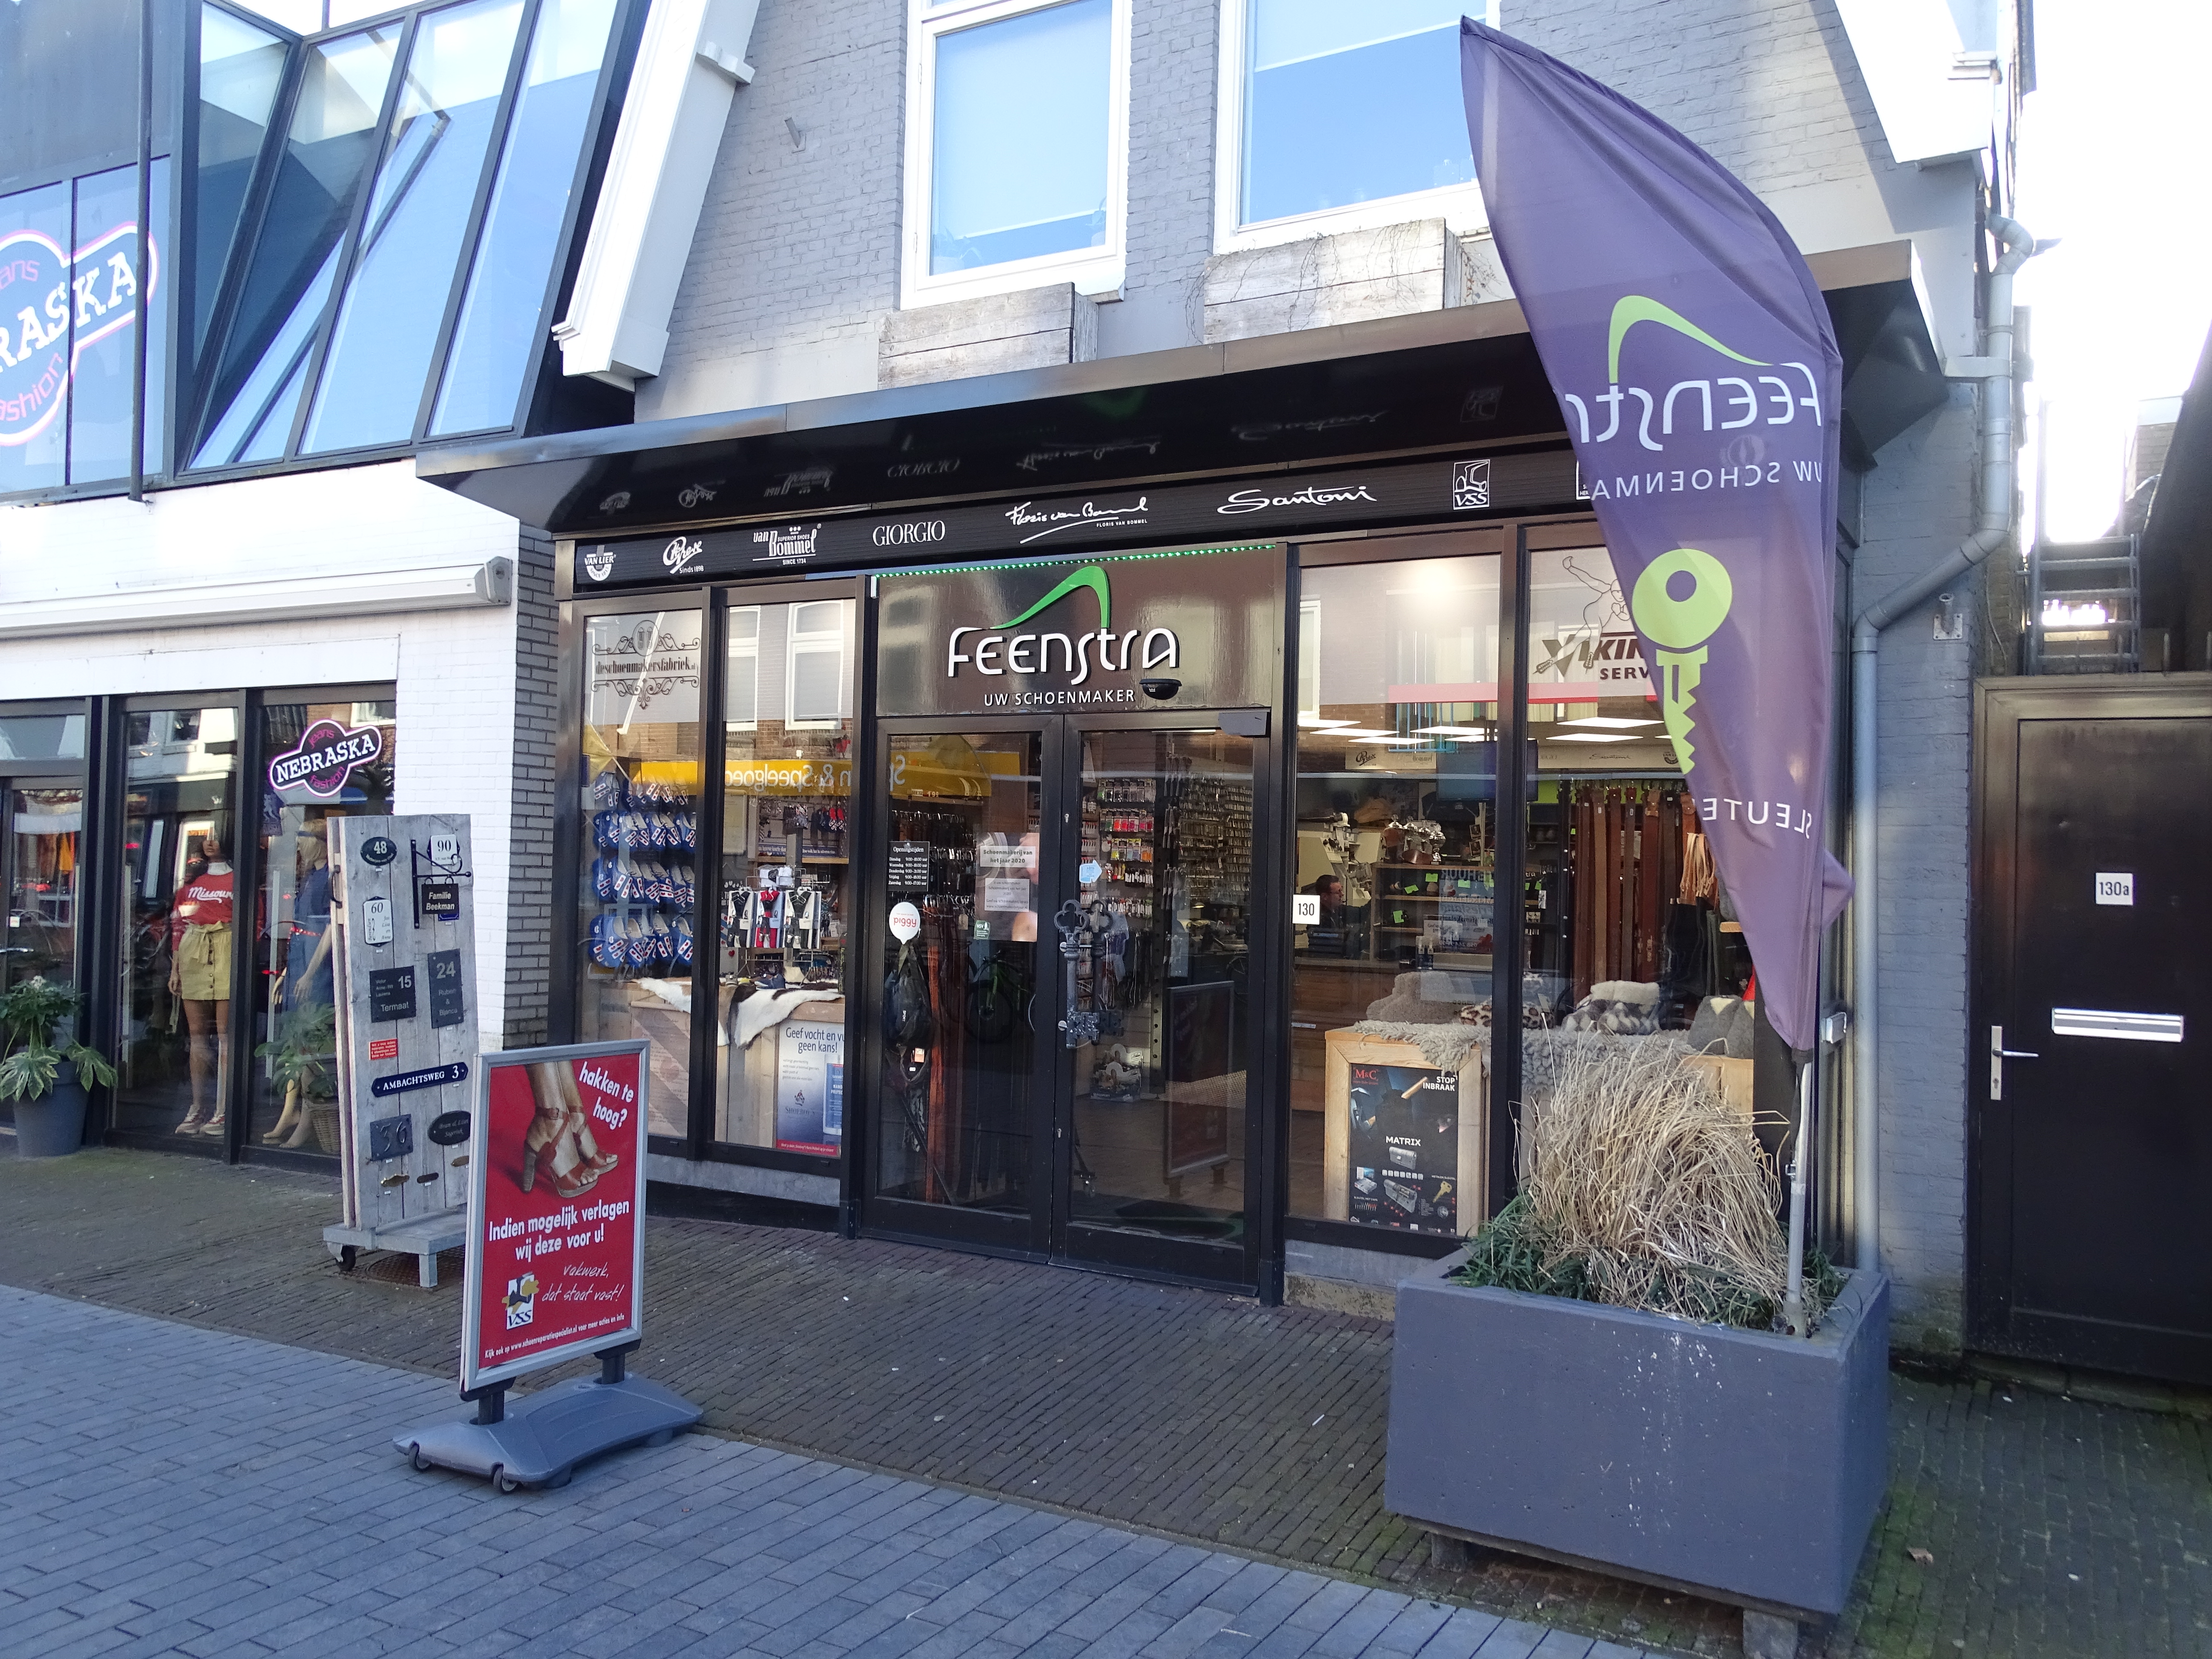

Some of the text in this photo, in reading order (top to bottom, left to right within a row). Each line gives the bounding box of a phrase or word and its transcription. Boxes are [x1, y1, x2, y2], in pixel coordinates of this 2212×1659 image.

[0, 259, 40, 290] ans
[0, 251, 137, 373] RASKA
[0, 352, 64, 422] ashion
[1217, 485, 1377, 514] Santoni
[1455, 492, 1487, 506] VSS
[1005, 501, 1047, 525] Floris
[1051, 512, 1080, 520] van
[753, 527, 816, 556] van Bommel
[873, 520, 946, 547] GIORGIO
[584, 556, 614, 565] VAN LIER
[1542, 634, 1644, 677] VIKIN
[1600, 667, 1649, 680] SERV
[984, 689, 1135, 706] UW SCHOENMAKER
[275, 734, 376, 783] NEBRASKA
[373, 841, 387, 854] 48
[437, 839, 451, 853] 90
[188, 886, 233, 903] Missour
[429, 891, 451, 900] Familie
[2098, 882, 2129, 896] 130a
[371, 902, 383, 914] 60
[426, 902, 455, 911] Beekman
[1298, 902, 1315, 917] 130
[894, 917, 917, 928] piggy
[436, 961, 456, 979] 24
[398, 975, 412, 989] 15
[381, 1001, 409, 1012] Termaat
[786, 1027, 804, 1039] Geef
[804, 1029, 825, 1040] vocht
[826, 1033, 835, 1041] en
[798, 1042, 838, 1054] geen kans!
[383, 1065, 459, 1091] AMBACHTSWEG 3
[579, 1061, 634, 1103] hakken te
[1355, 1069, 1377, 1080] M&C
[1436, 1076, 1455, 1084] STOP
[1423, 1082, 1455, 1091] INBRAAK
[592, 1097, 628, 1130] hoog?
[1385, 1135, 1421, 1147] MATRIX
[489, 1199, 629, 1241] Indien mogelijk verlagen
[515, 1223, 605, 1262] wij deze voor u!
[542, 1283, 625, 1302] dat staat vast!
[506, 1309, 533, 1327] VSS
[485, 1348, 495, 1359] Kijk
[496, 1345, 504, 1356] ook
[504, 1346, 510, 1354] op
[588, 1321, 598, 1330] meer
[599, 1318, 610, 1326] acties
[617, 1313, 625, 1321] info
